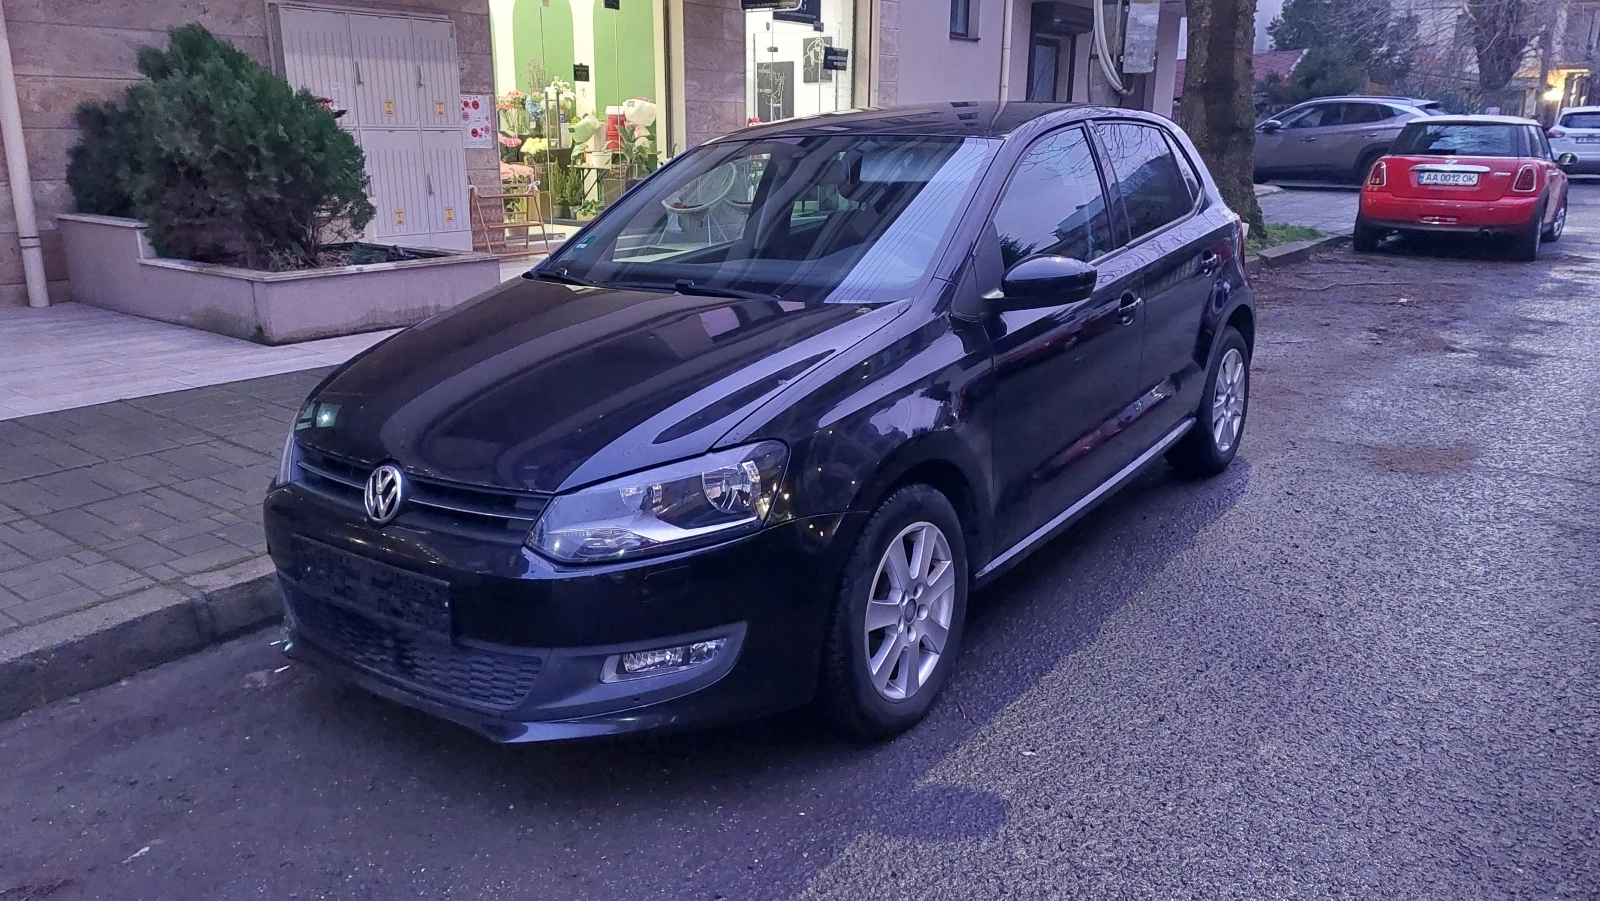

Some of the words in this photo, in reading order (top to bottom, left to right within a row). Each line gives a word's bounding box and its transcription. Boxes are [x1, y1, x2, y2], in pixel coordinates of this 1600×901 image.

[1425, 173, 1438, 182] AA
[1440, 174, 1460, 182] 0012
[1463, 174, 1476, 182] OK
